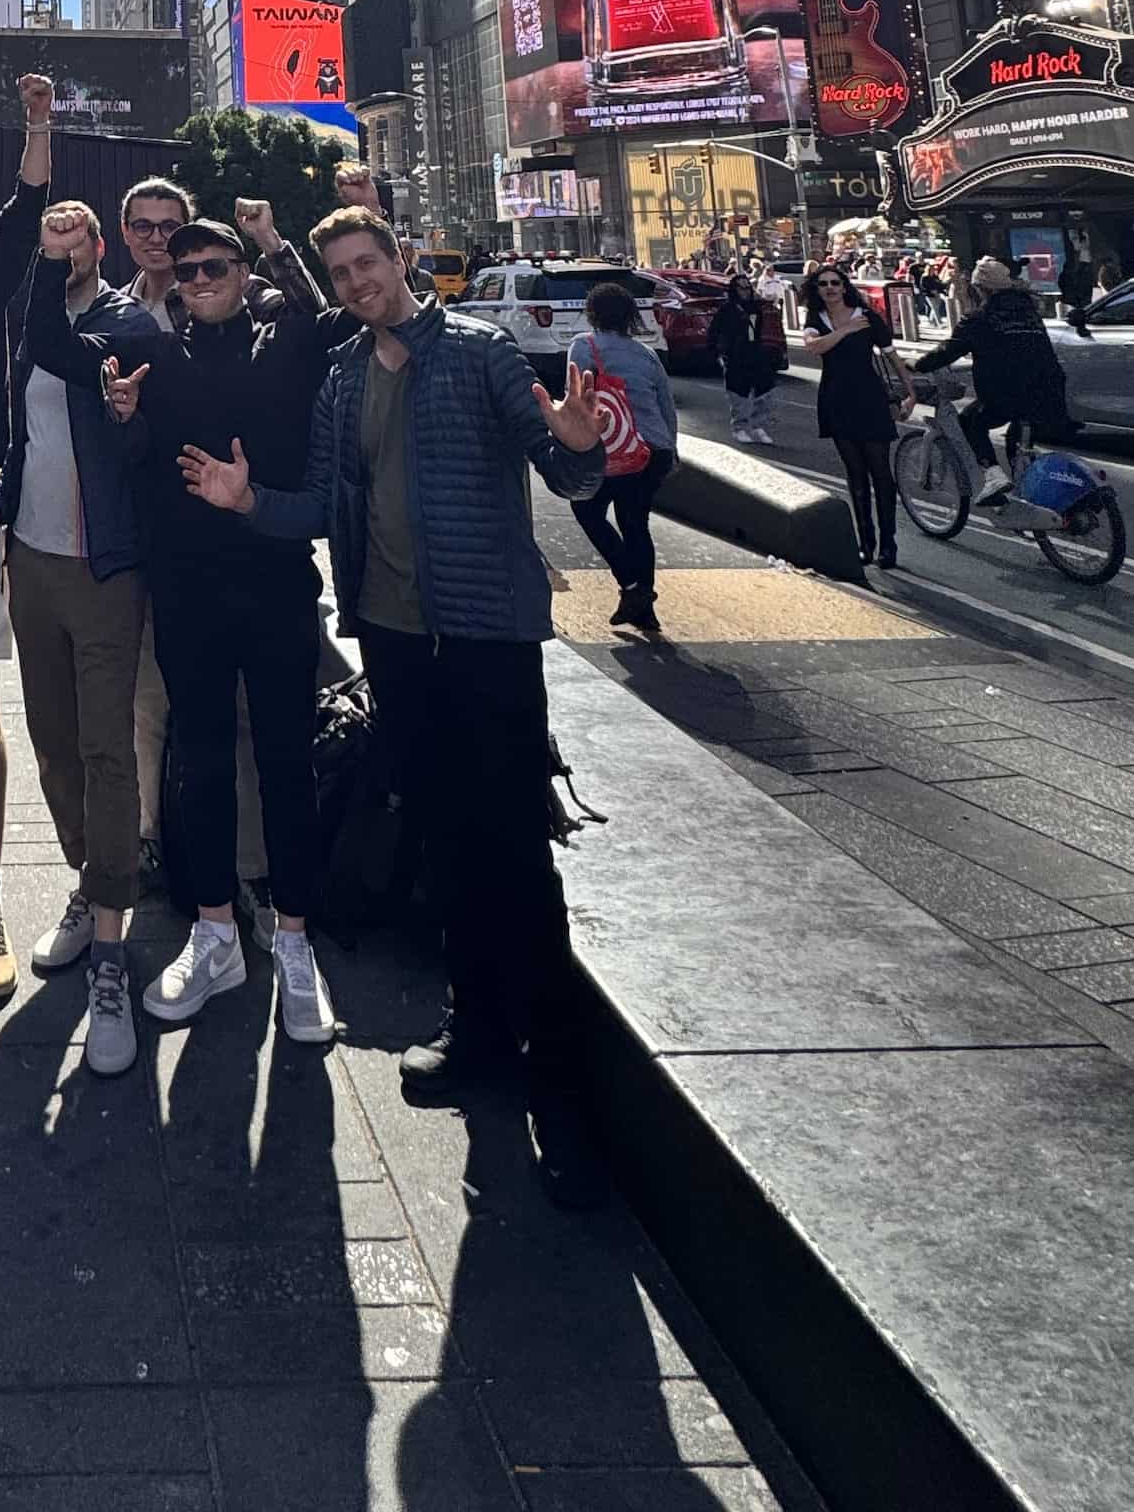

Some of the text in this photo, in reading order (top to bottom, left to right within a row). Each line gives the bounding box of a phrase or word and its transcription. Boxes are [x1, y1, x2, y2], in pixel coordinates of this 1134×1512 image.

[252, 7, 340, 23] TAIWAN
[990, 46, 1082, 84] Hard Rock
[822, 81, 905, 103] Hard Rock
[411, 61, 431, 204] TIMES SQUARE
[953, 106, 1129, 140] WORK HARD, HAPPY HOUR HARDER
